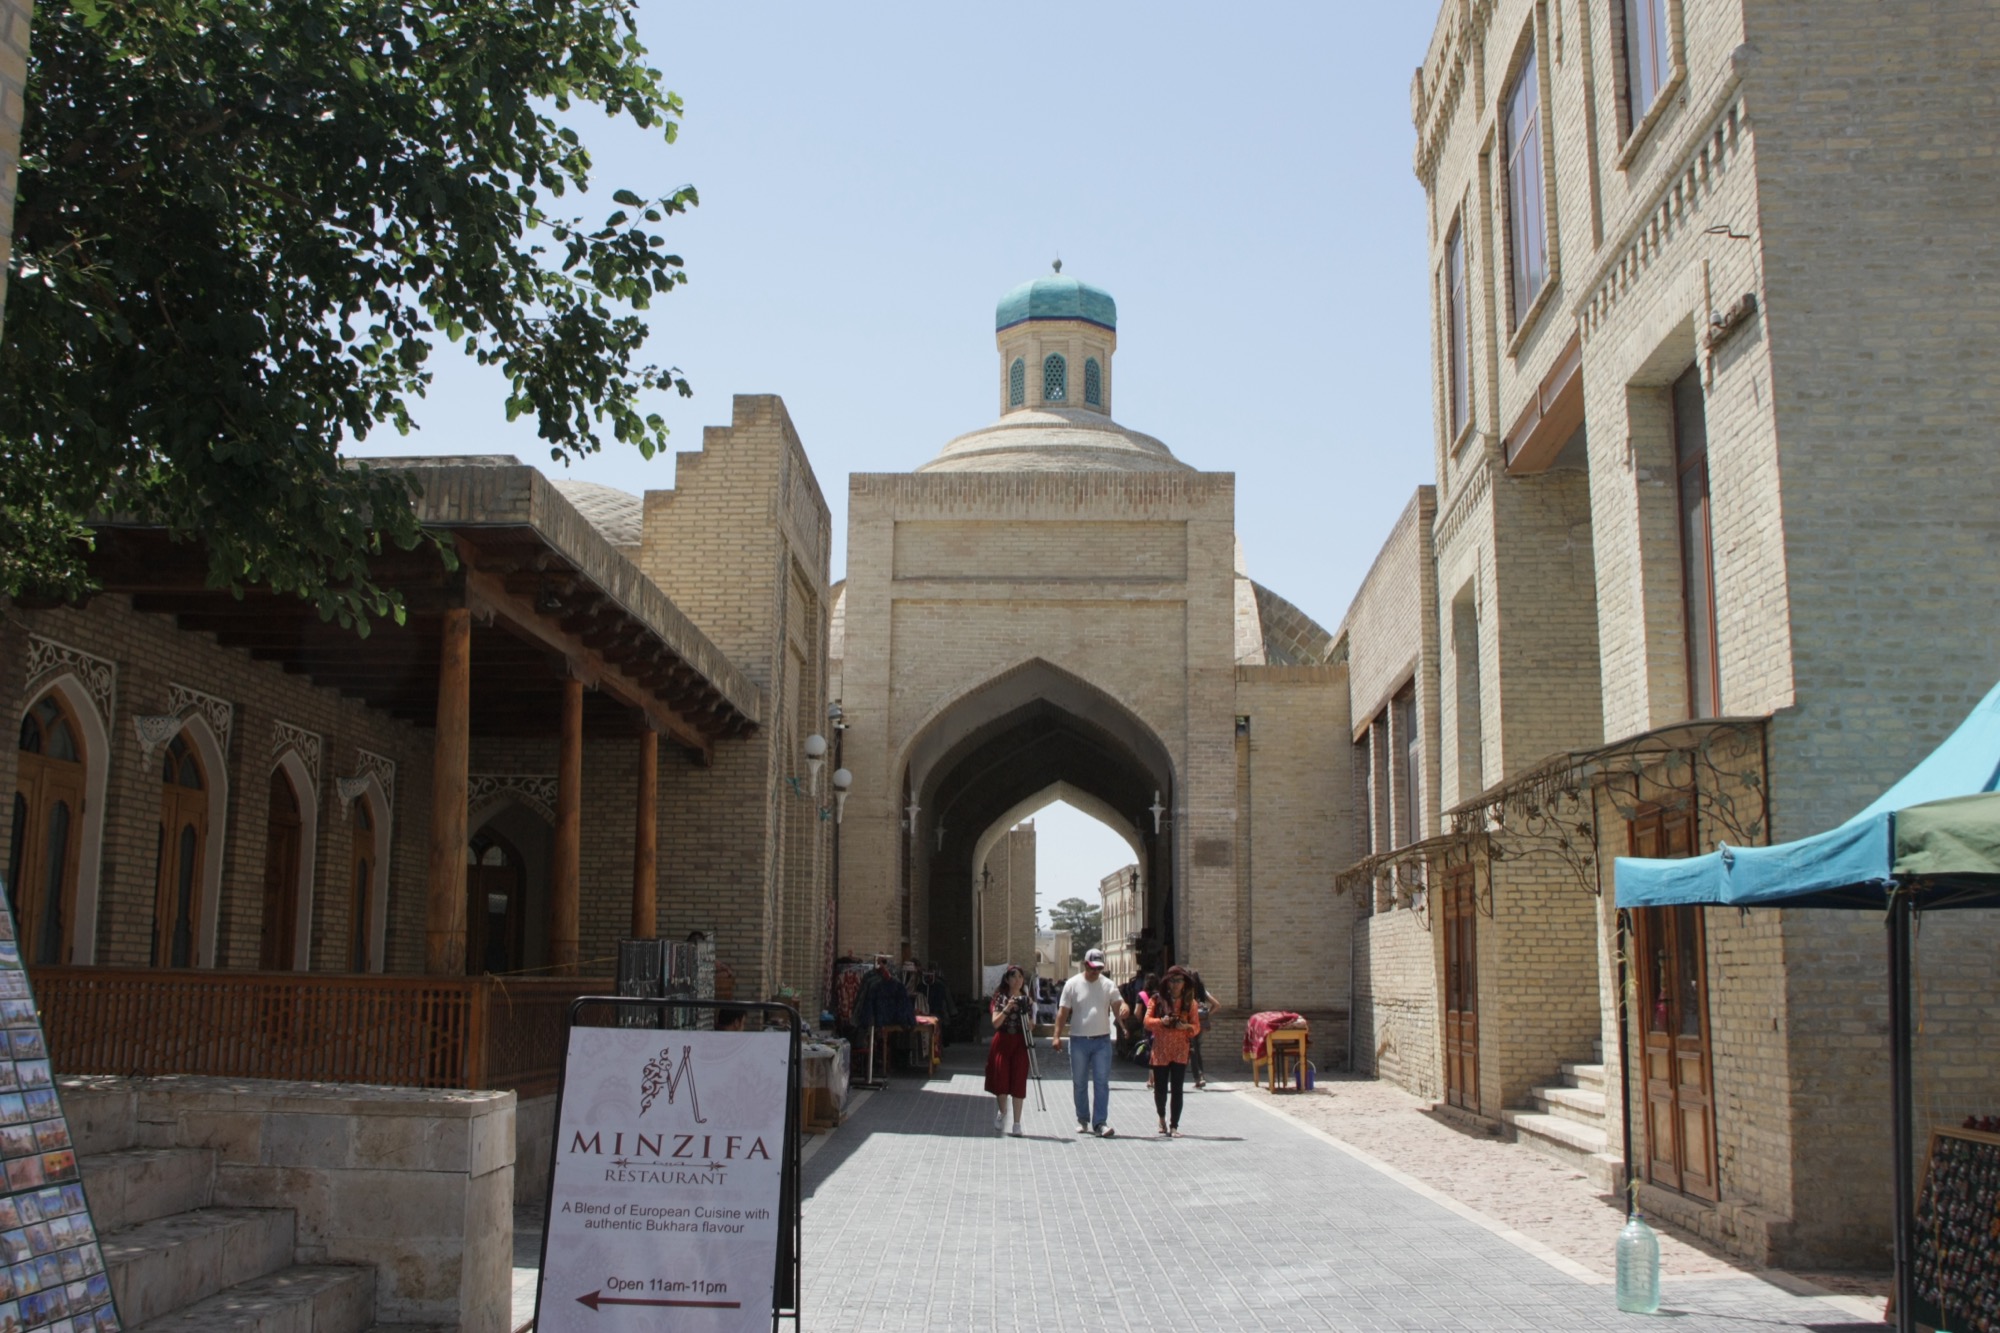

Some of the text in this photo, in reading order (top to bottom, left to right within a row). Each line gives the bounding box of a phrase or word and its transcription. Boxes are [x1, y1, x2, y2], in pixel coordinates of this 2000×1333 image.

[570, 1130, 772, 1160] MINZIFA
[604, 1169, 728, 1185] RESTAURANT
[561, 1202, 770, 1220] A Blend of European Cuisine with
[584, 1218, 745, 1234] authentic Bukhara flavour
[607, 1276, 727, 1295] Open 11am-11pm
